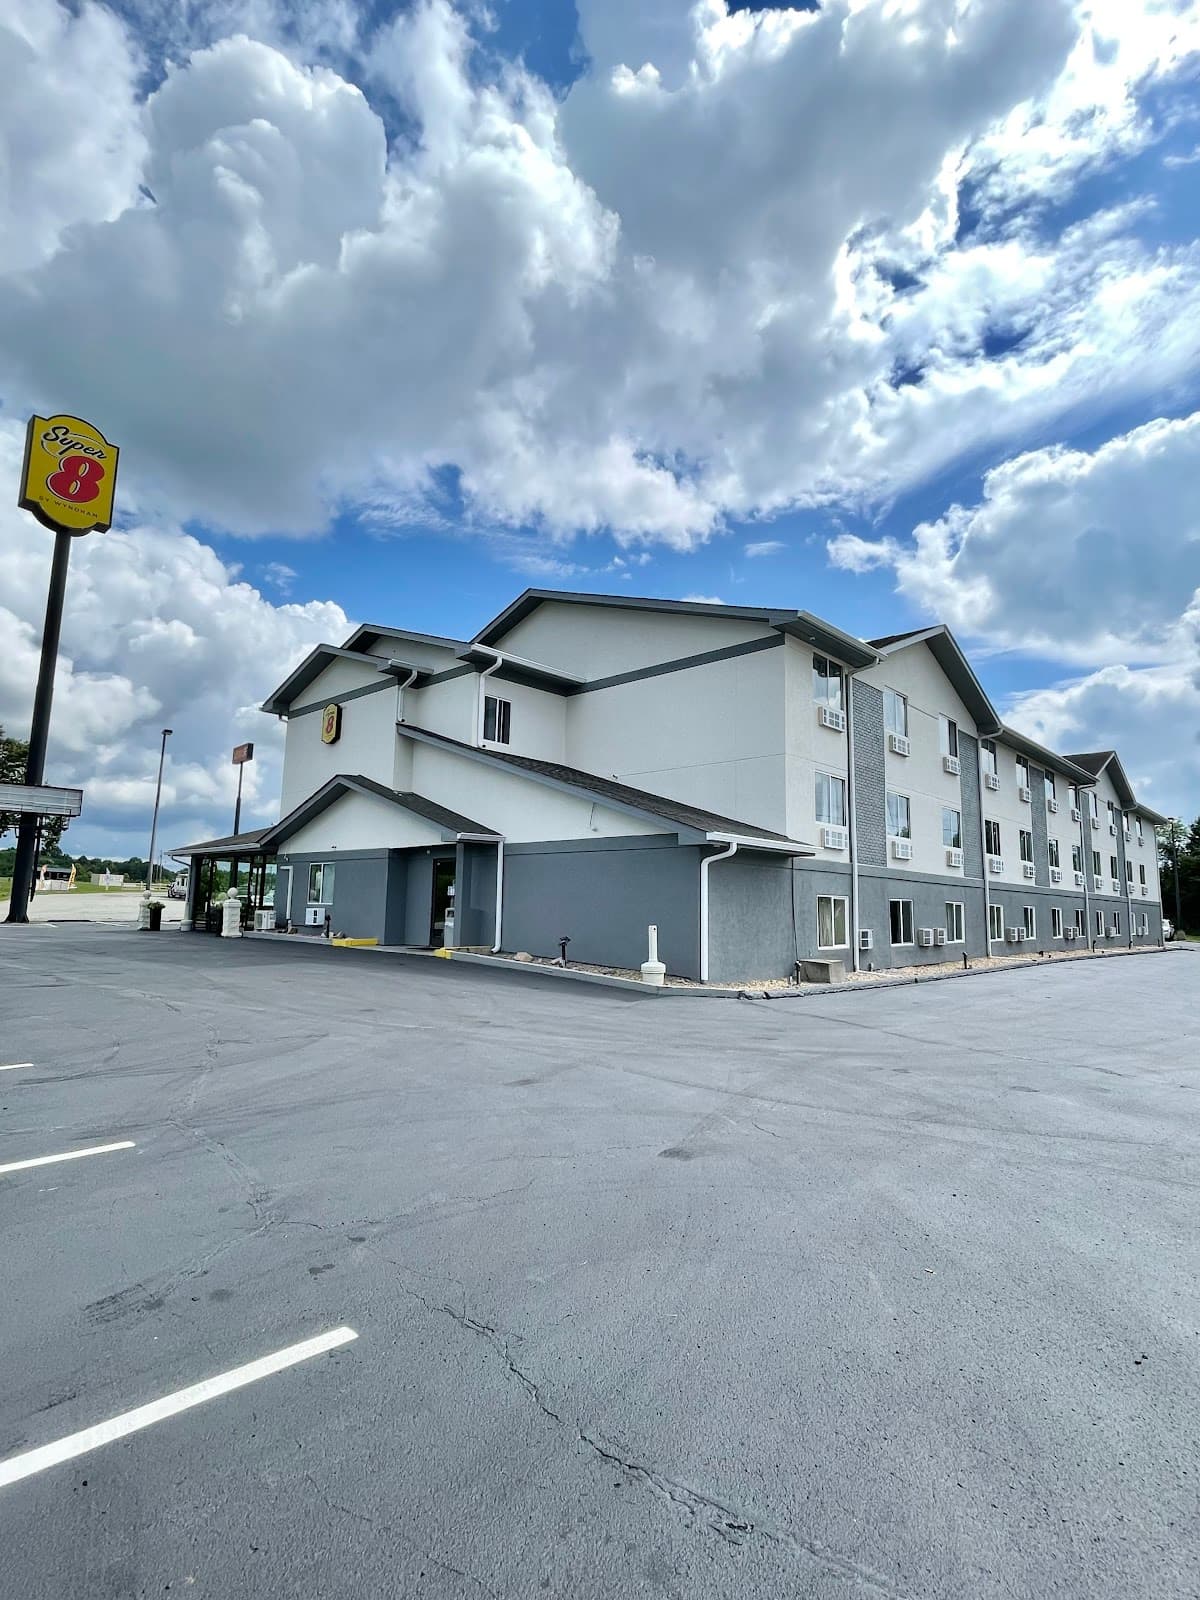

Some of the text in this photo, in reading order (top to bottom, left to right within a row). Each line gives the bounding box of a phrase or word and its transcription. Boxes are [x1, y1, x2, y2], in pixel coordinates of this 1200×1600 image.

[42, 426, 107, 459] Super
[46, 455, 105, 503] 8
[38, 495, 98, 518] BY WYNDHAM
